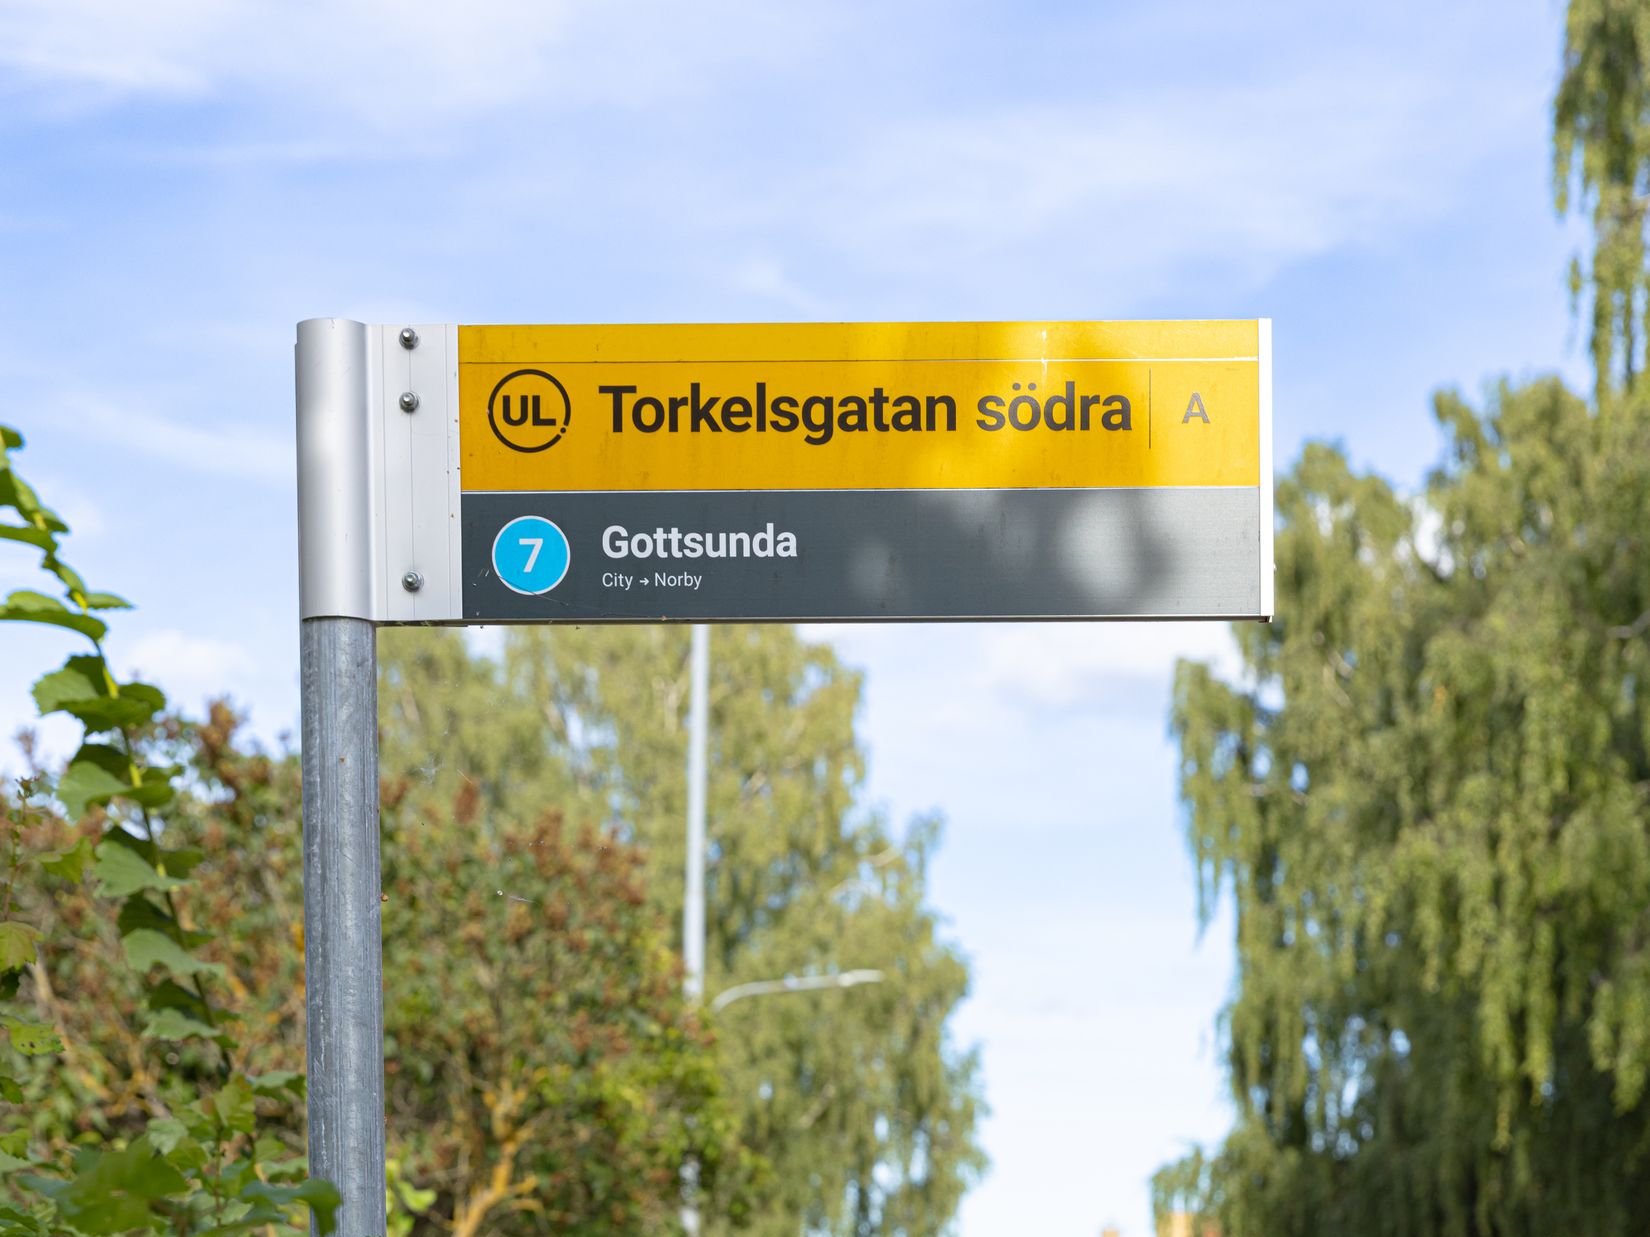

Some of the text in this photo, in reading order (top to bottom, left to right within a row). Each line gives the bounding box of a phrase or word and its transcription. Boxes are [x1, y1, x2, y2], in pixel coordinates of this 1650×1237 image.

[502, 394, 557, 427] UL
[598, 381, 1133, 446] Torkelsgatan södra
[1181, 391, 1211, 425] A
[518, 537, 544, 574] 7
[601, 522, 798, 559] Gottsunda
[602, 571, 703, 591] City Norby
